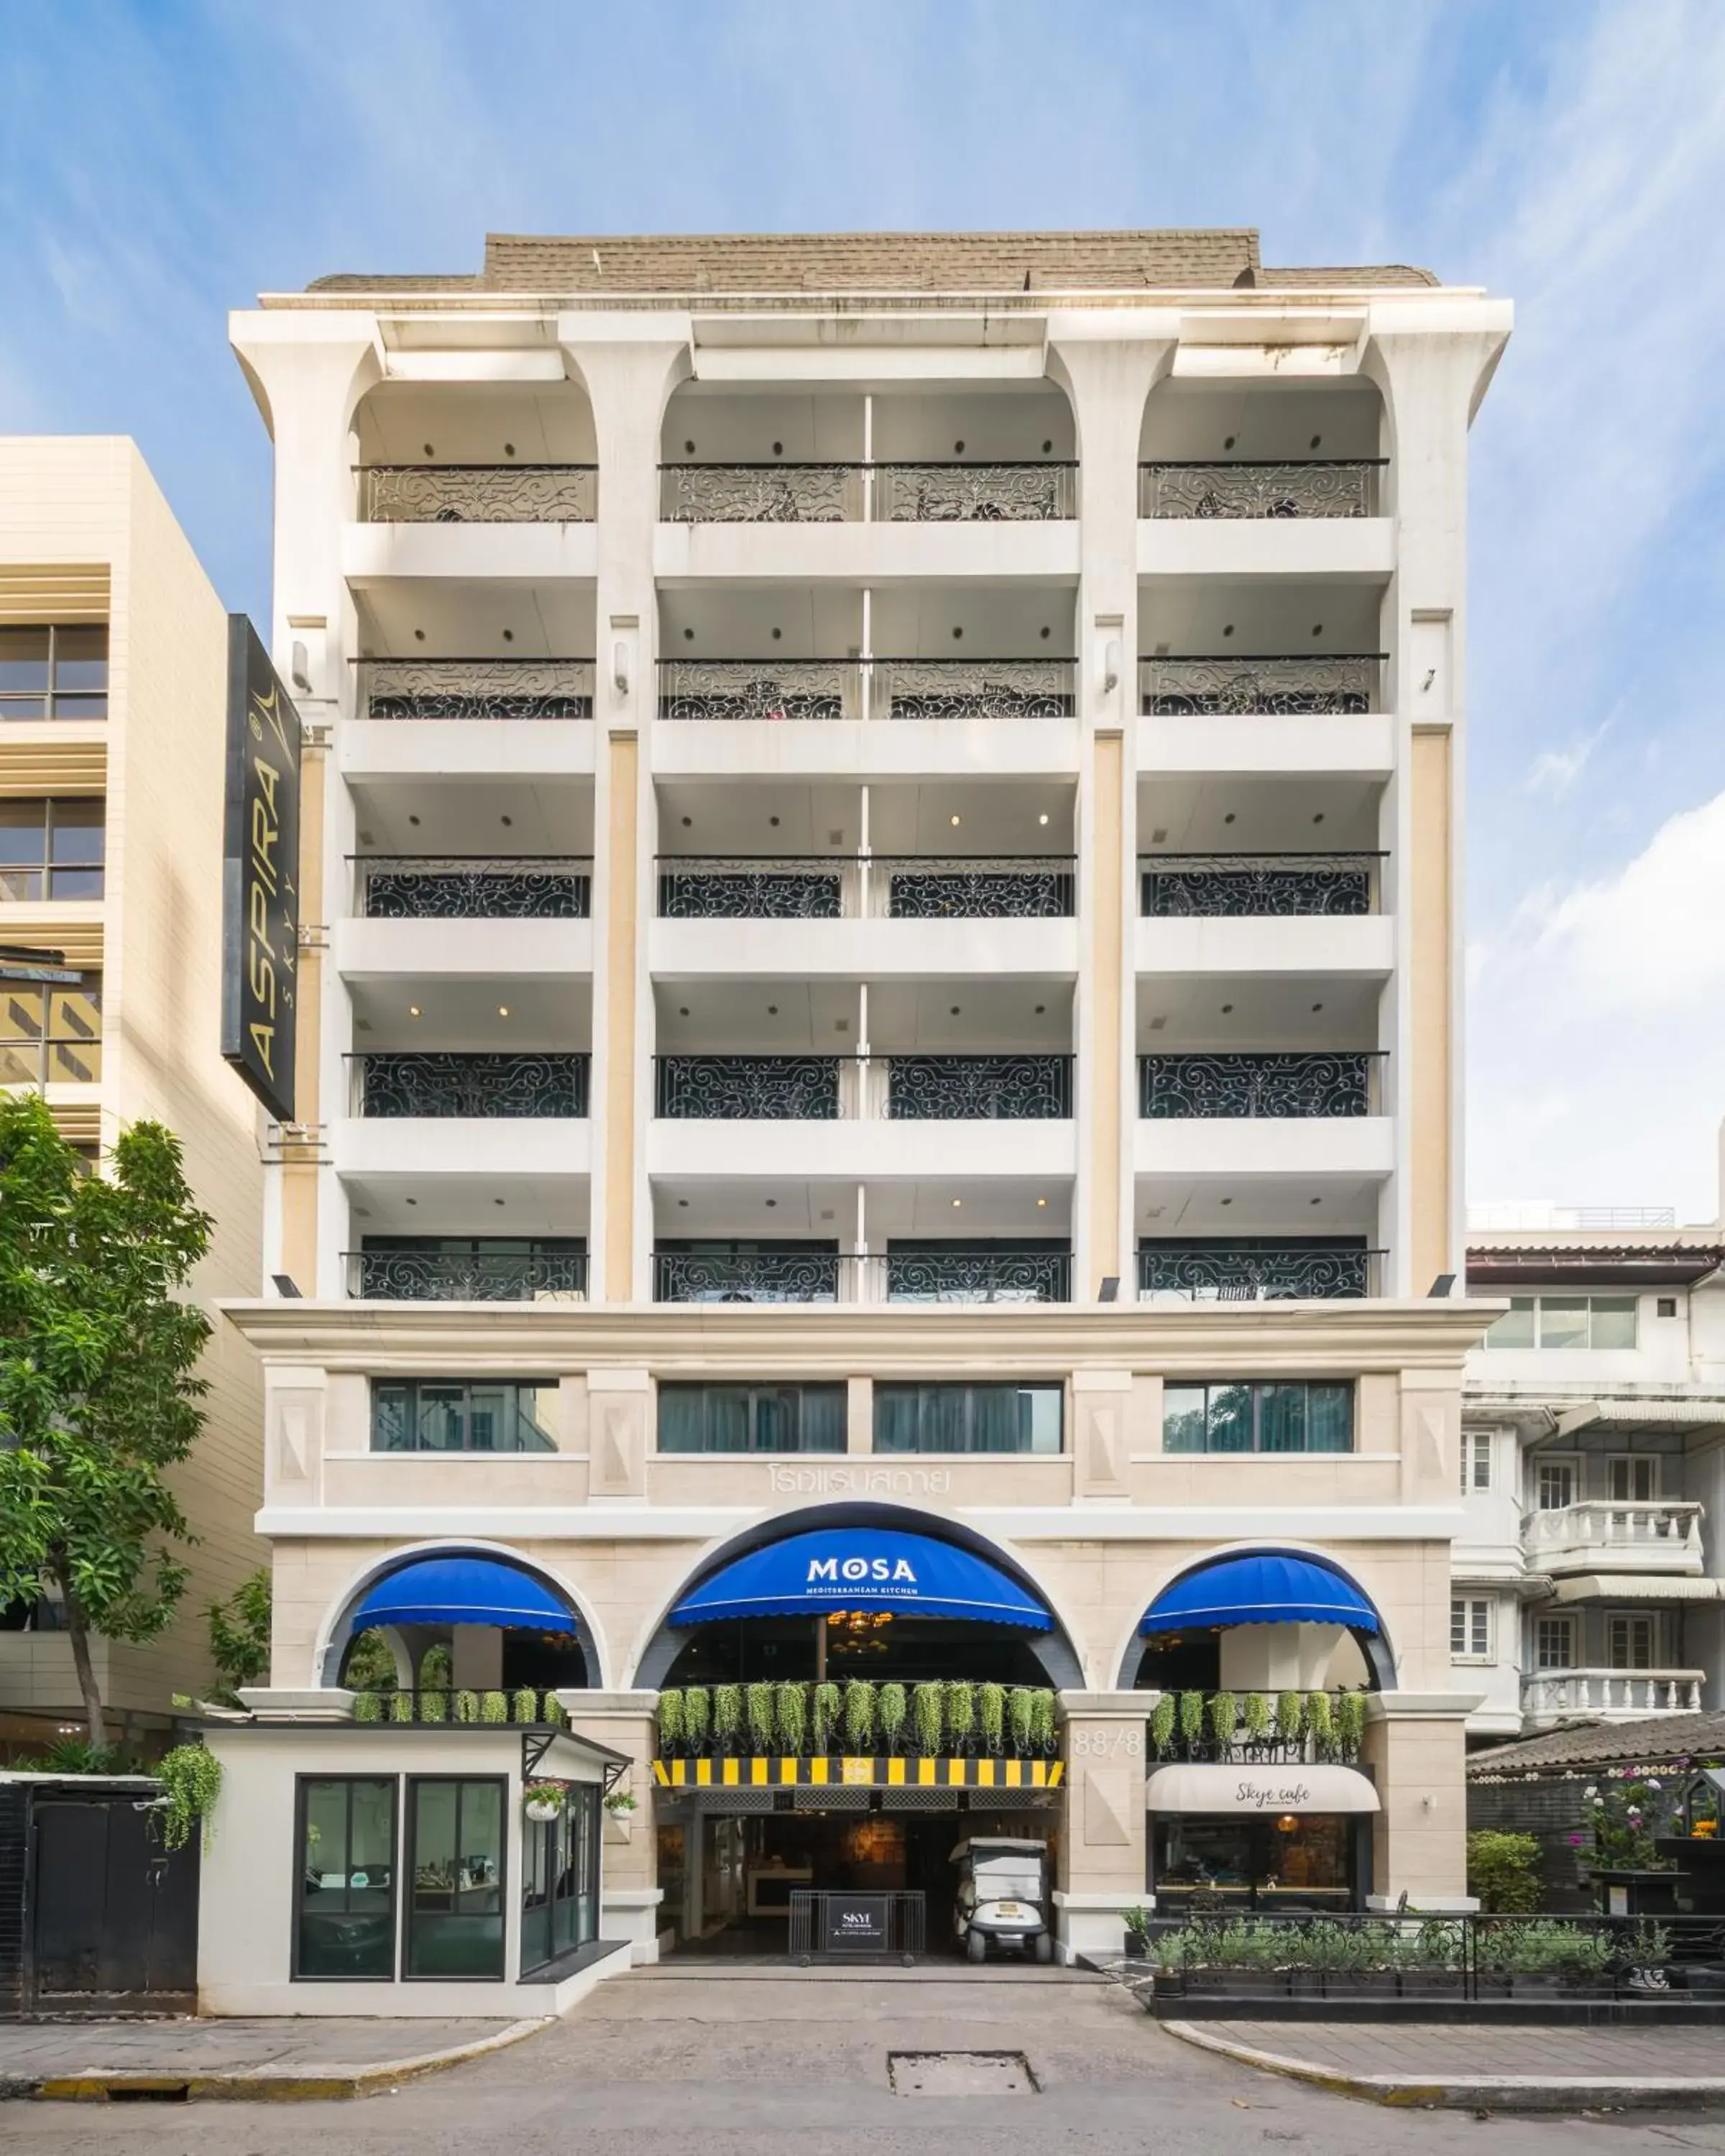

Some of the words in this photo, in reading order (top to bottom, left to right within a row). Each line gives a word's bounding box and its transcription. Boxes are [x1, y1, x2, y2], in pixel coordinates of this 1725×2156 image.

[249, 755, 280, 1083] ASPIRA
[282, 872, 296, 1009] SKYY
[806, 1557, 918, 1583] MOSA
[806, 1586, 878, 1595] MEDITERRANEAN
[880, 1586, 919, 1595] KITCHEN
